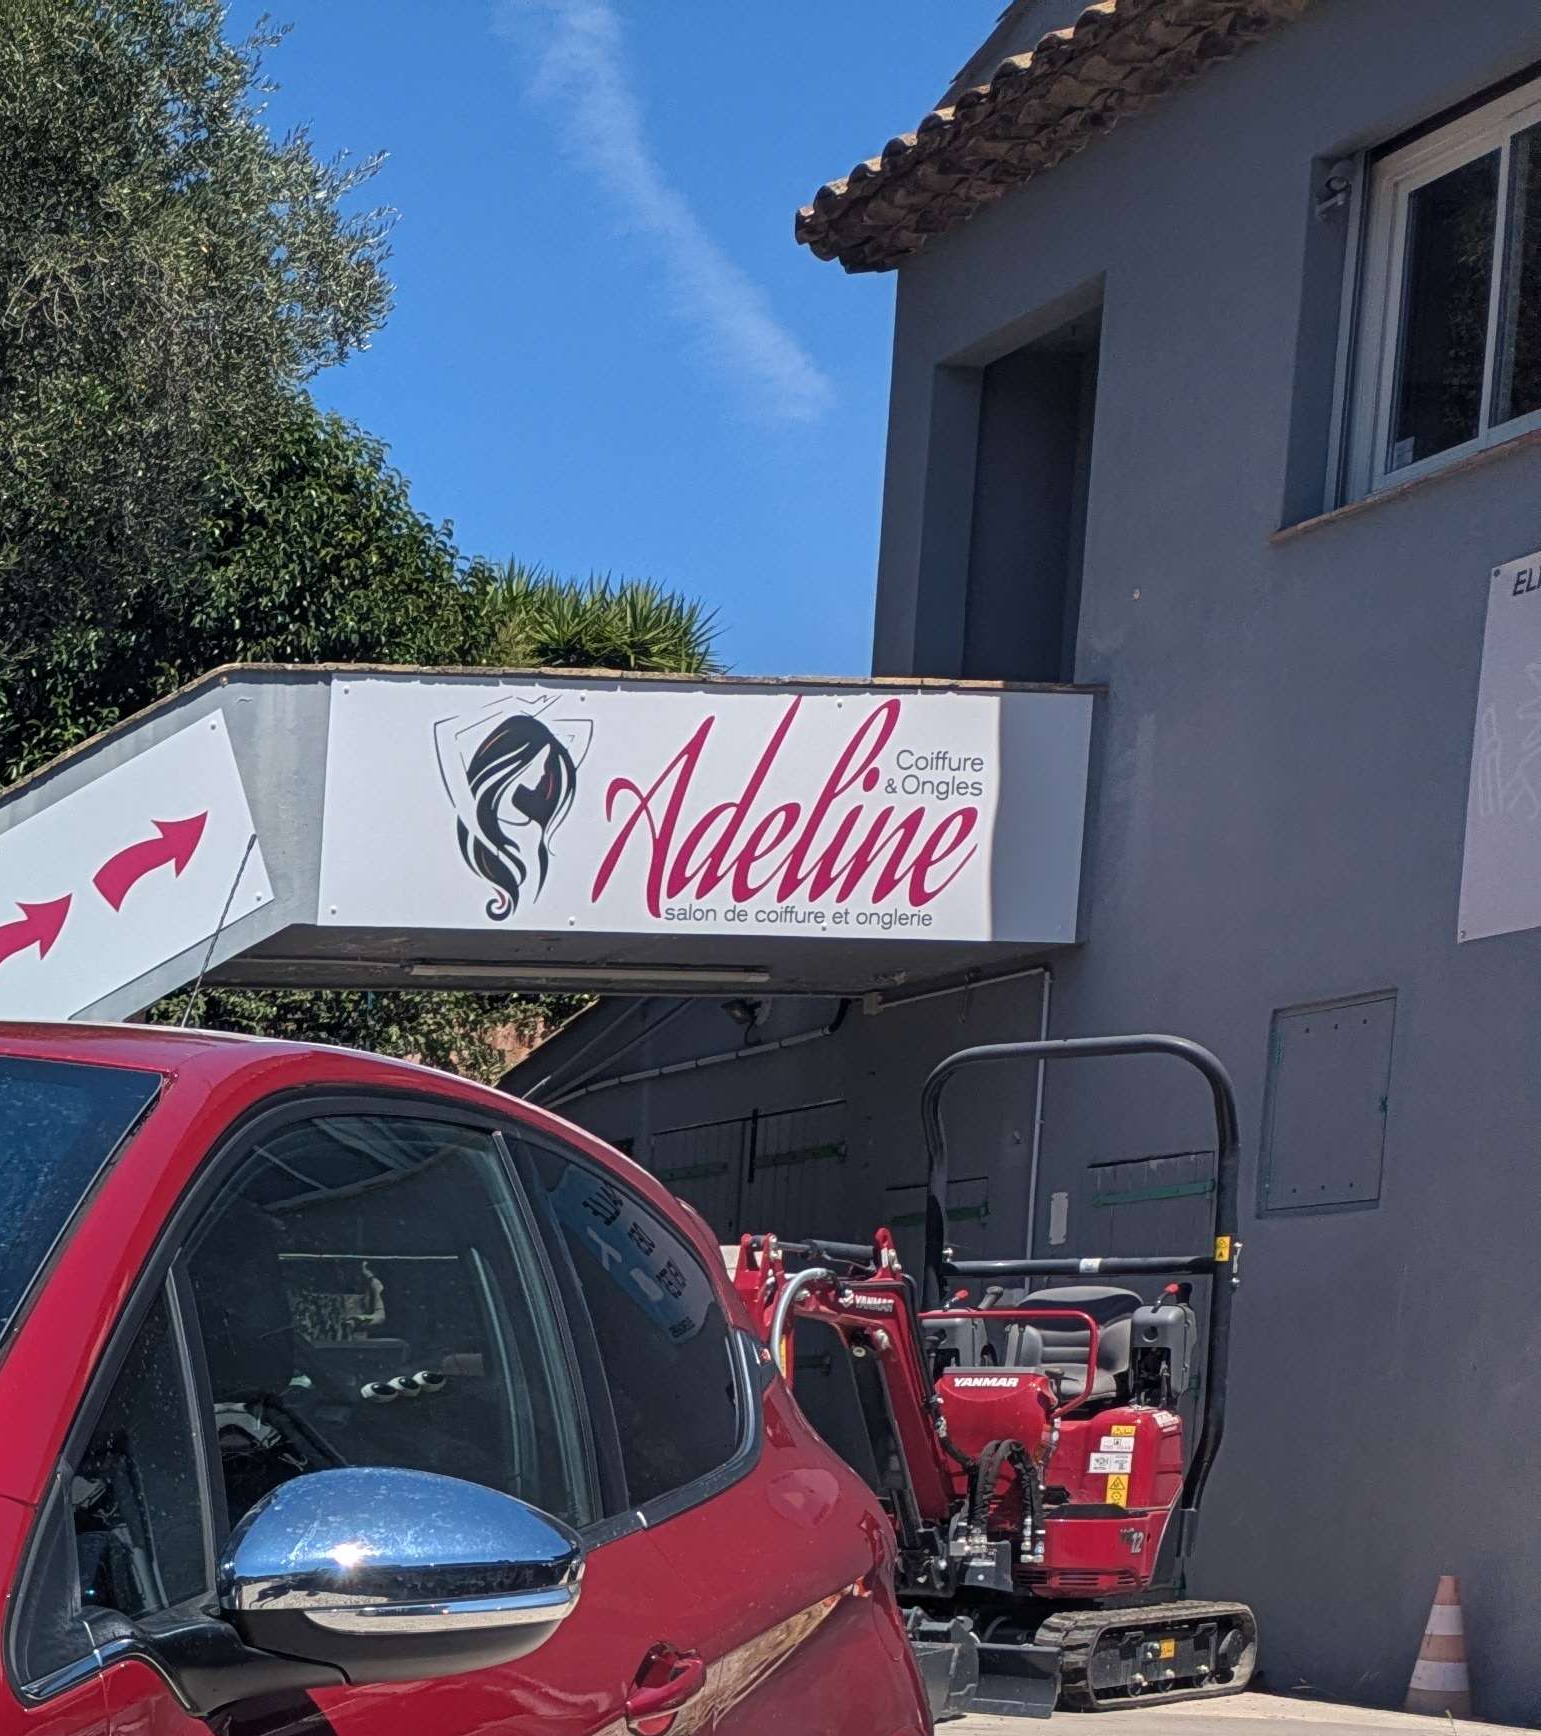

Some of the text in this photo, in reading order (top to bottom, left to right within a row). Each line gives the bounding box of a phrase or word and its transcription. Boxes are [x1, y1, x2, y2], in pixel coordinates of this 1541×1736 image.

[896, 749, 984, 773] Coiffure
[884, 774, 983, 801] & Ongles
[591, 694, 979, 919] Adeline
[664, 903, 933, 930] salon de coiffure et onglerie
[855, 1294, 894, 1313] YANMAR
[954, 1377, 1019, 1388] YANMAR
